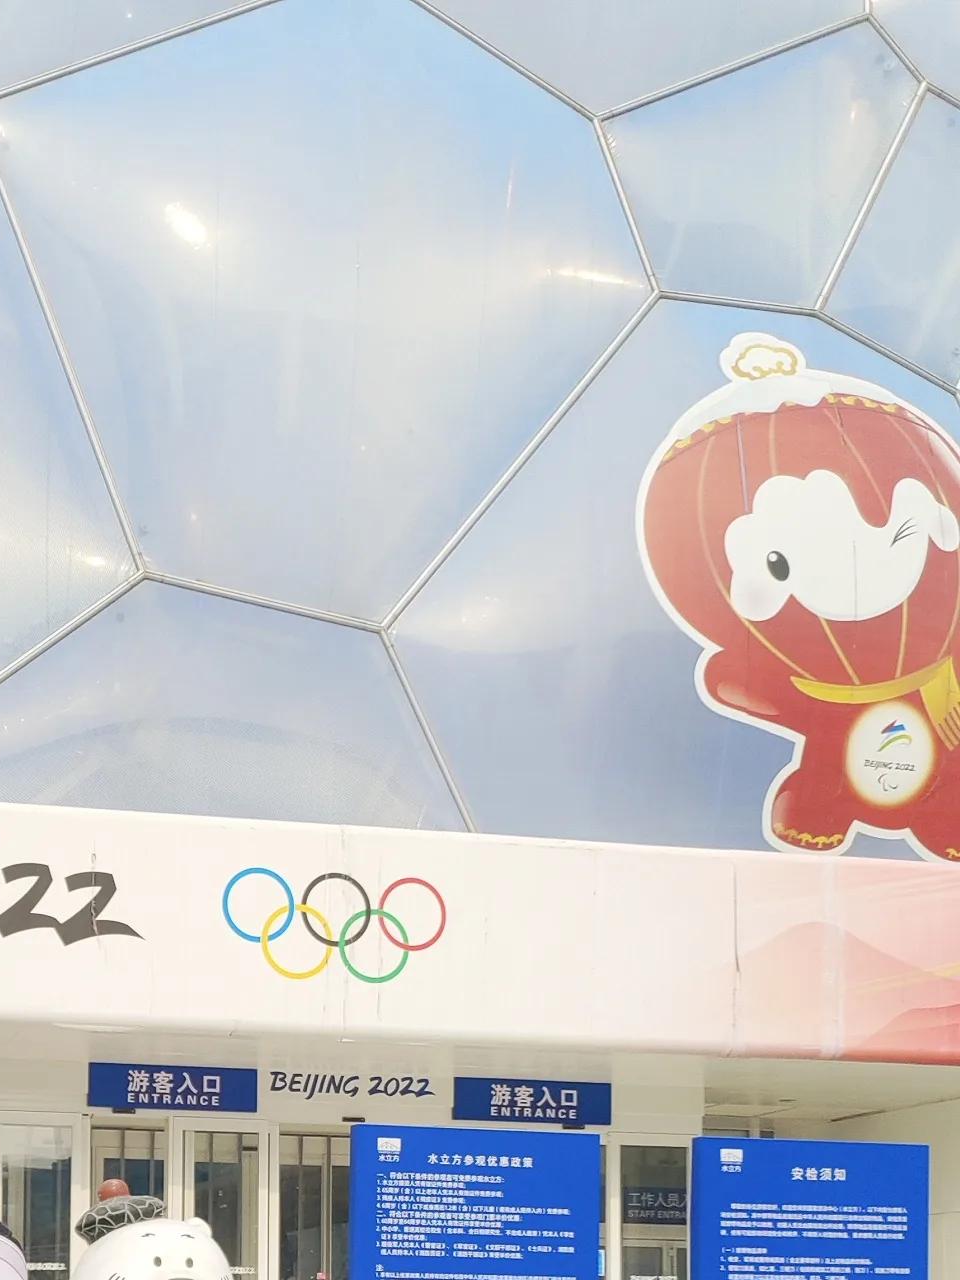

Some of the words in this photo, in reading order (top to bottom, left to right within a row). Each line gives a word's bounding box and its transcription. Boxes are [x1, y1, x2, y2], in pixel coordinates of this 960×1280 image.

[863, 759, 893, 771] BEIJING
[895, 762, 917, 772] 2022
[127, 1070, 221, 1094] 游客入口
[269, 1071, 360, 1100] BEIJING
[367, 1076, 436, 1098] 2022
[127, 1092, 220, 1106] ENTRANCE
[490, 1084, 578, 1108] 游客入口
[490, 1106, 577, 1119] ENTRANCE
[378, 1154, 400, 1162] 水立方
[427, 1153, 534, 1168] 水立方参观优惠政策
[791, 1167, 846, 1181] 安检须知
